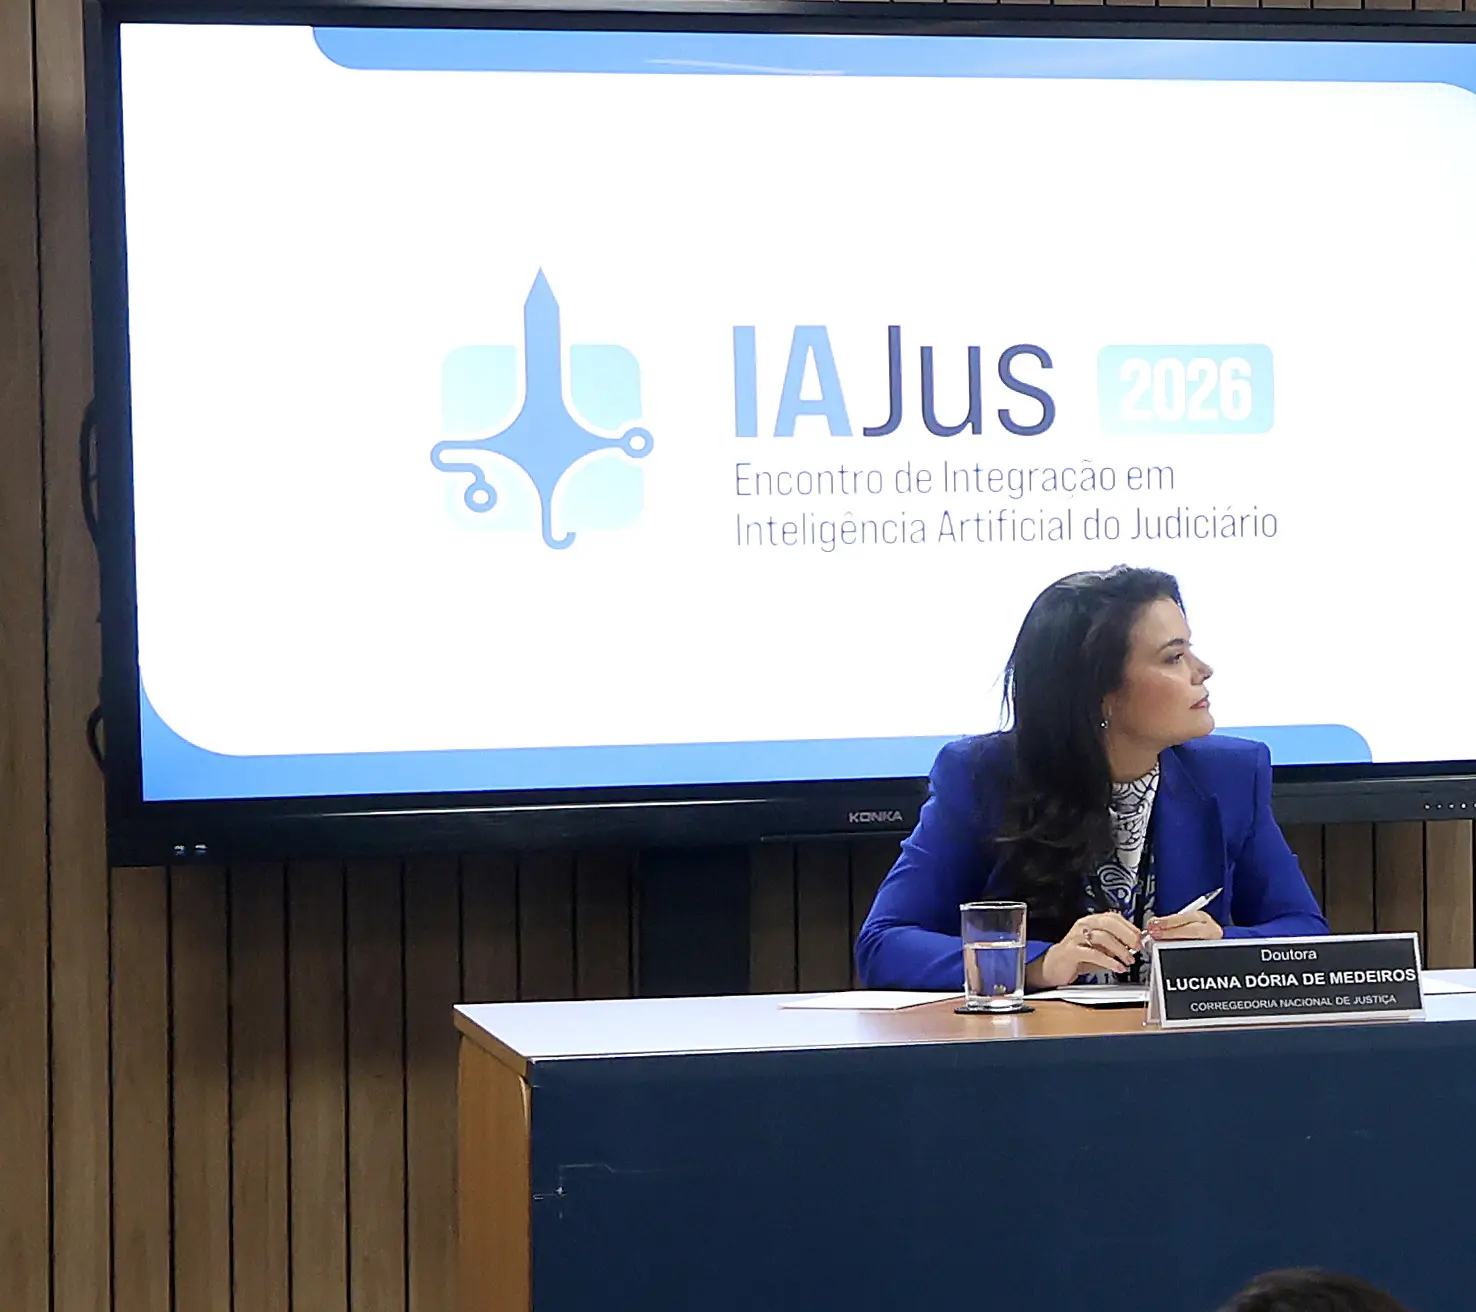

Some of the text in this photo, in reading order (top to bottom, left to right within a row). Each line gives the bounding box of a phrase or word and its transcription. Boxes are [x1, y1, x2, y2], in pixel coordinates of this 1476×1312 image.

[732, 324, 1253, 438] IAJus 2026
[735, 459, 1174, 501] Encontro de Integração em
[736, 505, 1278, 553] Inteligência Artificial do Judiciário
[848, 810, 904, 824] KONKA
[1261, 947, 1317, 963] Doutora
[1166, 968, 1416, 992] LUCIANA DÓRIA DE MEDEIROS
[1190, 993, 1397, 1013] CORREGEDORIA NACIONAL DE JUSTIÇA
